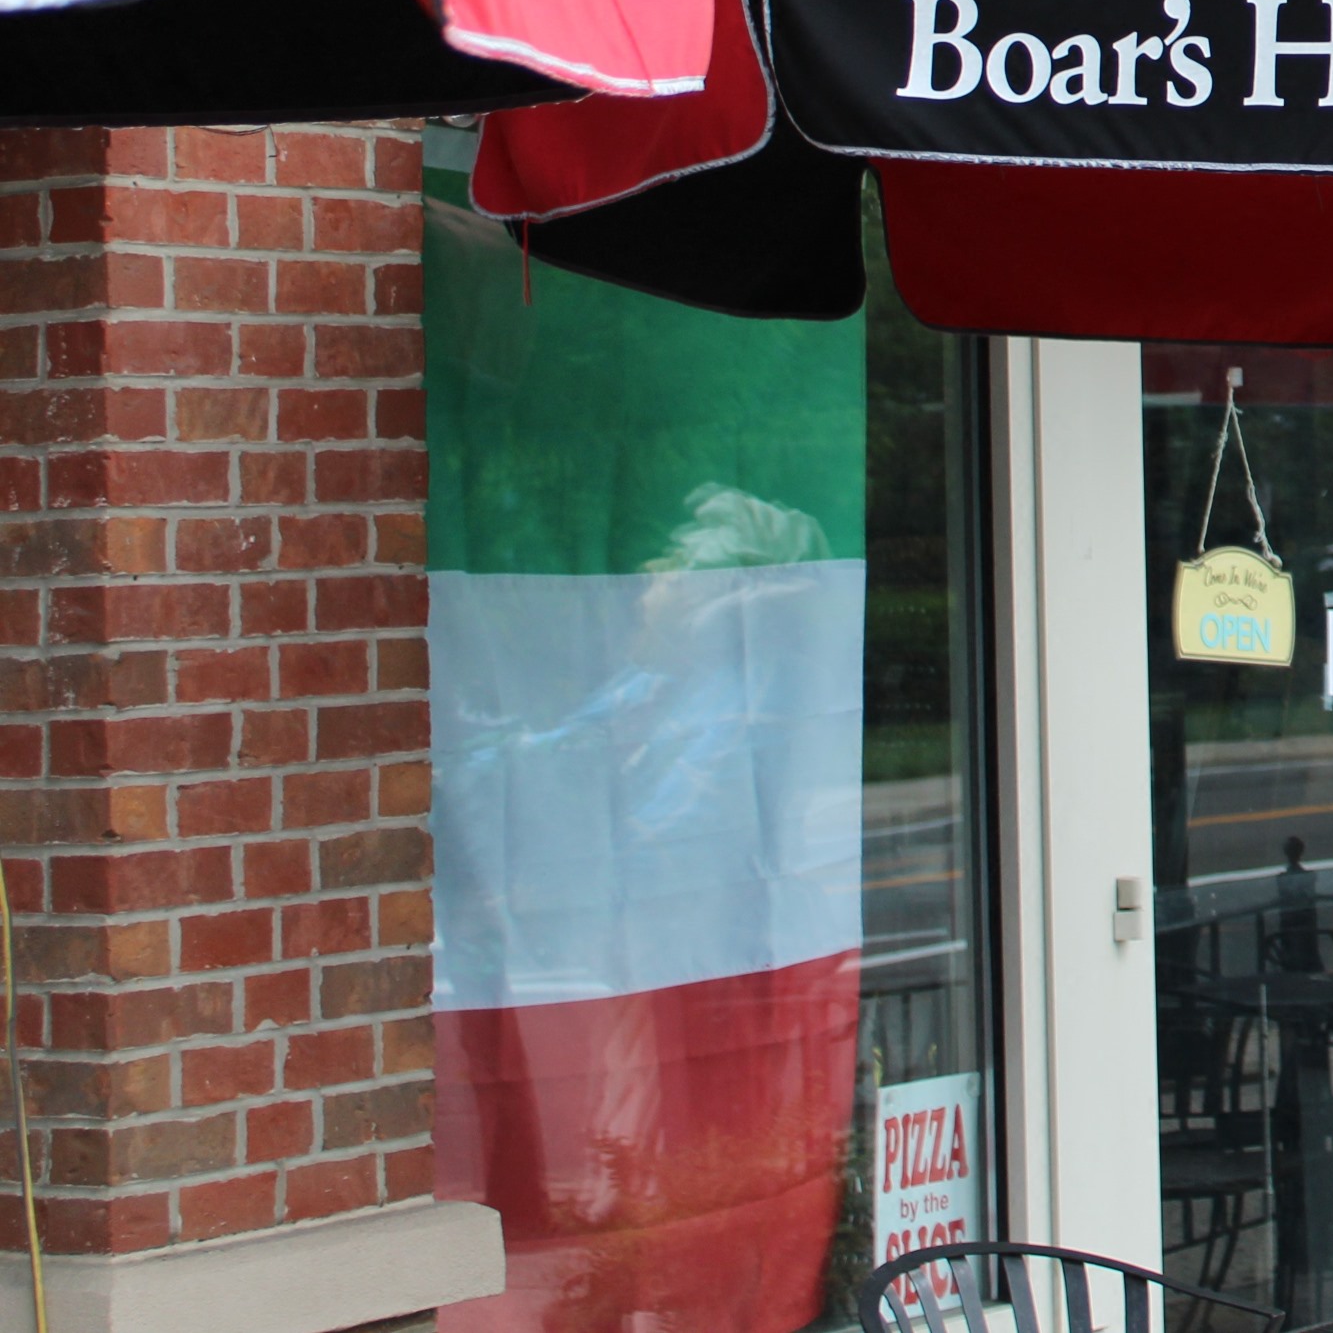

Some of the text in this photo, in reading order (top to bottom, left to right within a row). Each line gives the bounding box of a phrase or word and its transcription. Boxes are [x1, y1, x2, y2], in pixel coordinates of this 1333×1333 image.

[1200, 612, 1273, 654] OPEN
[882, 1103, 969, 1194] PIZZA
[900, 1192, 949, 1222] by the
